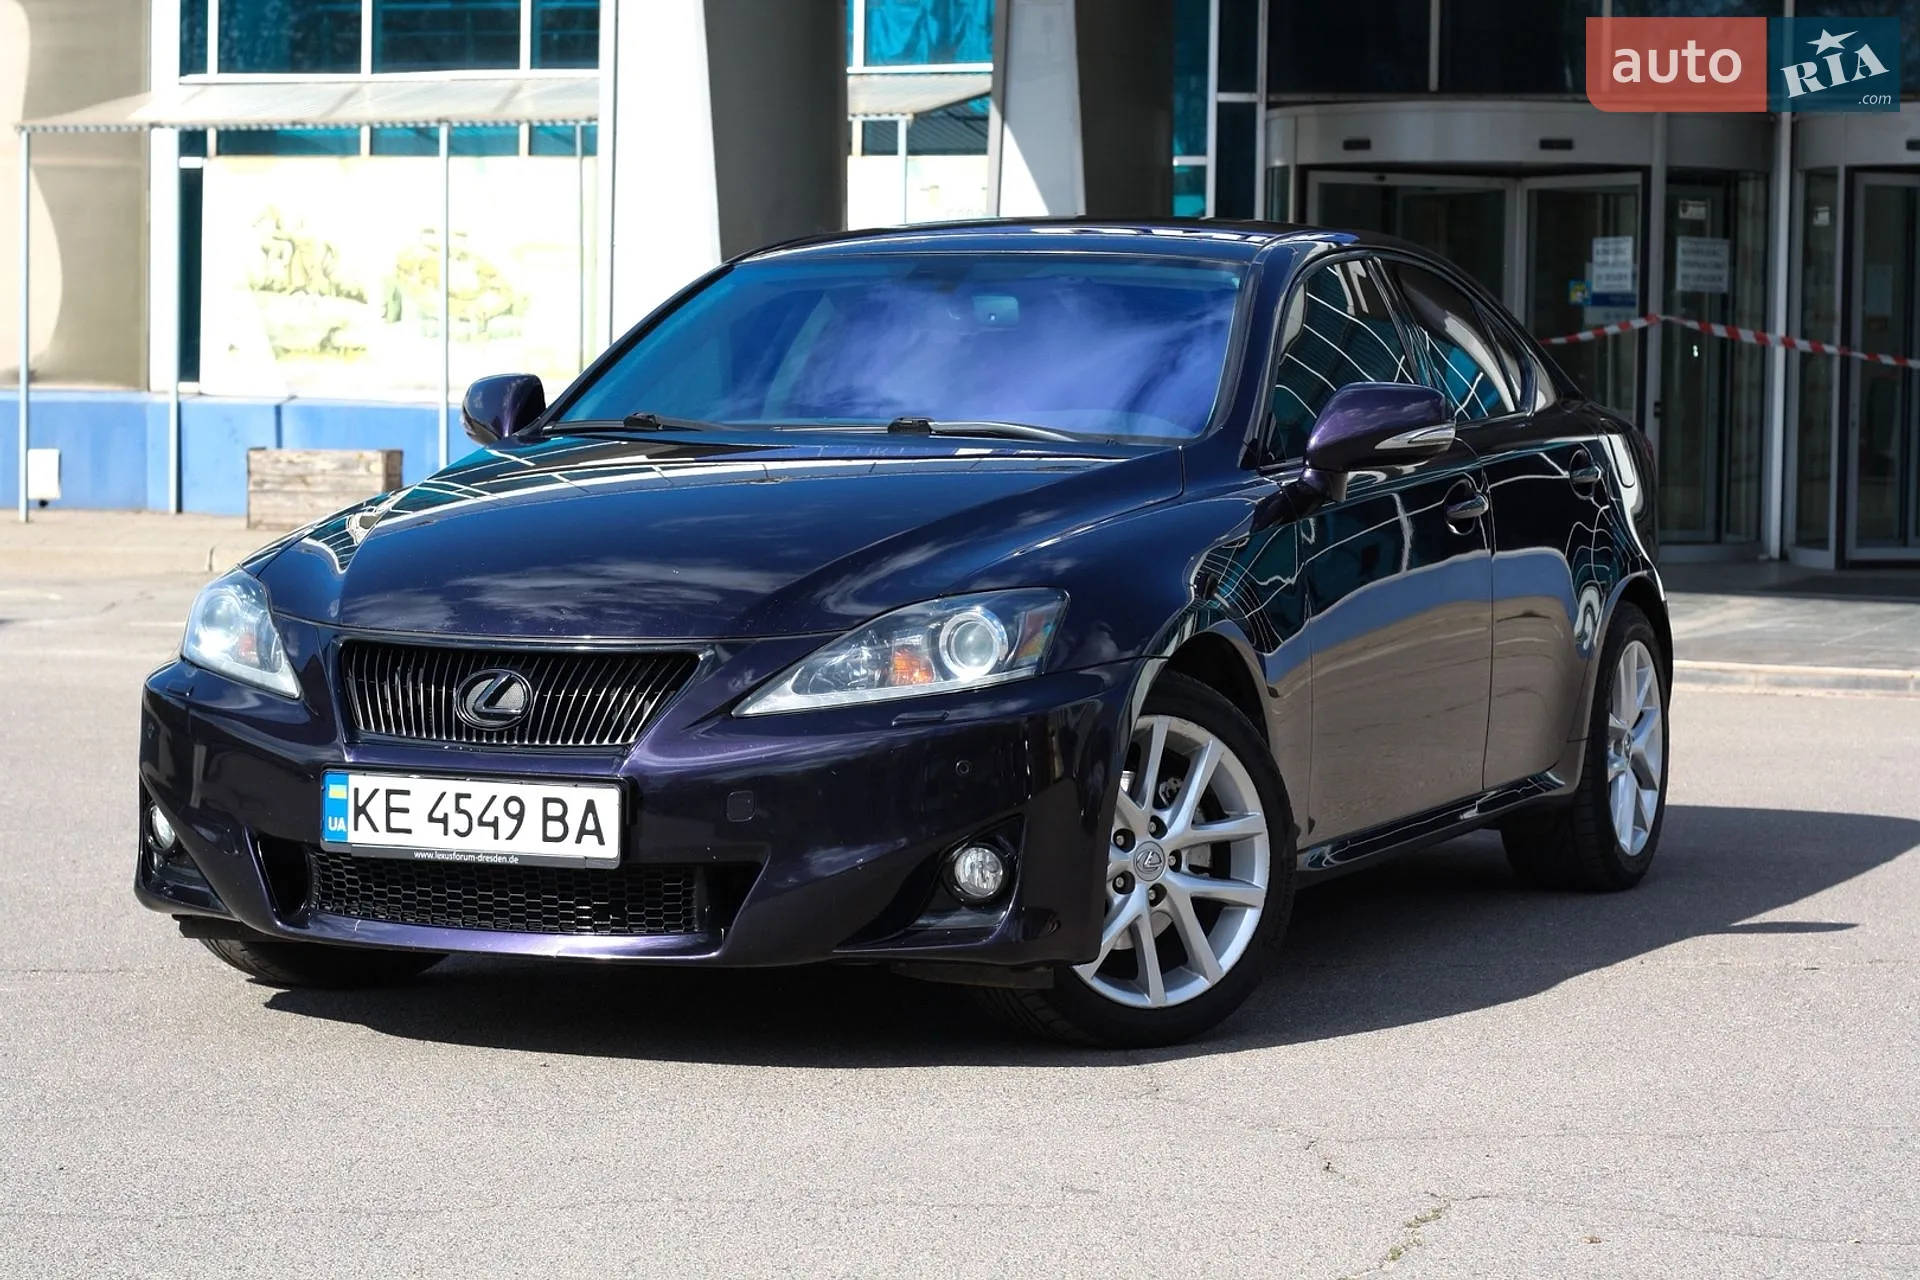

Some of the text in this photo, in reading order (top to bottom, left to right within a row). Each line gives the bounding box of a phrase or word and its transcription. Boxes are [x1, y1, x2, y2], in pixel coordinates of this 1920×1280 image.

[328, 816, 347, 832] UA
[353, 787, 605, 846] KE 4549 BA
[413, 850, 519, 864] www.lexusforum-dresden.de
